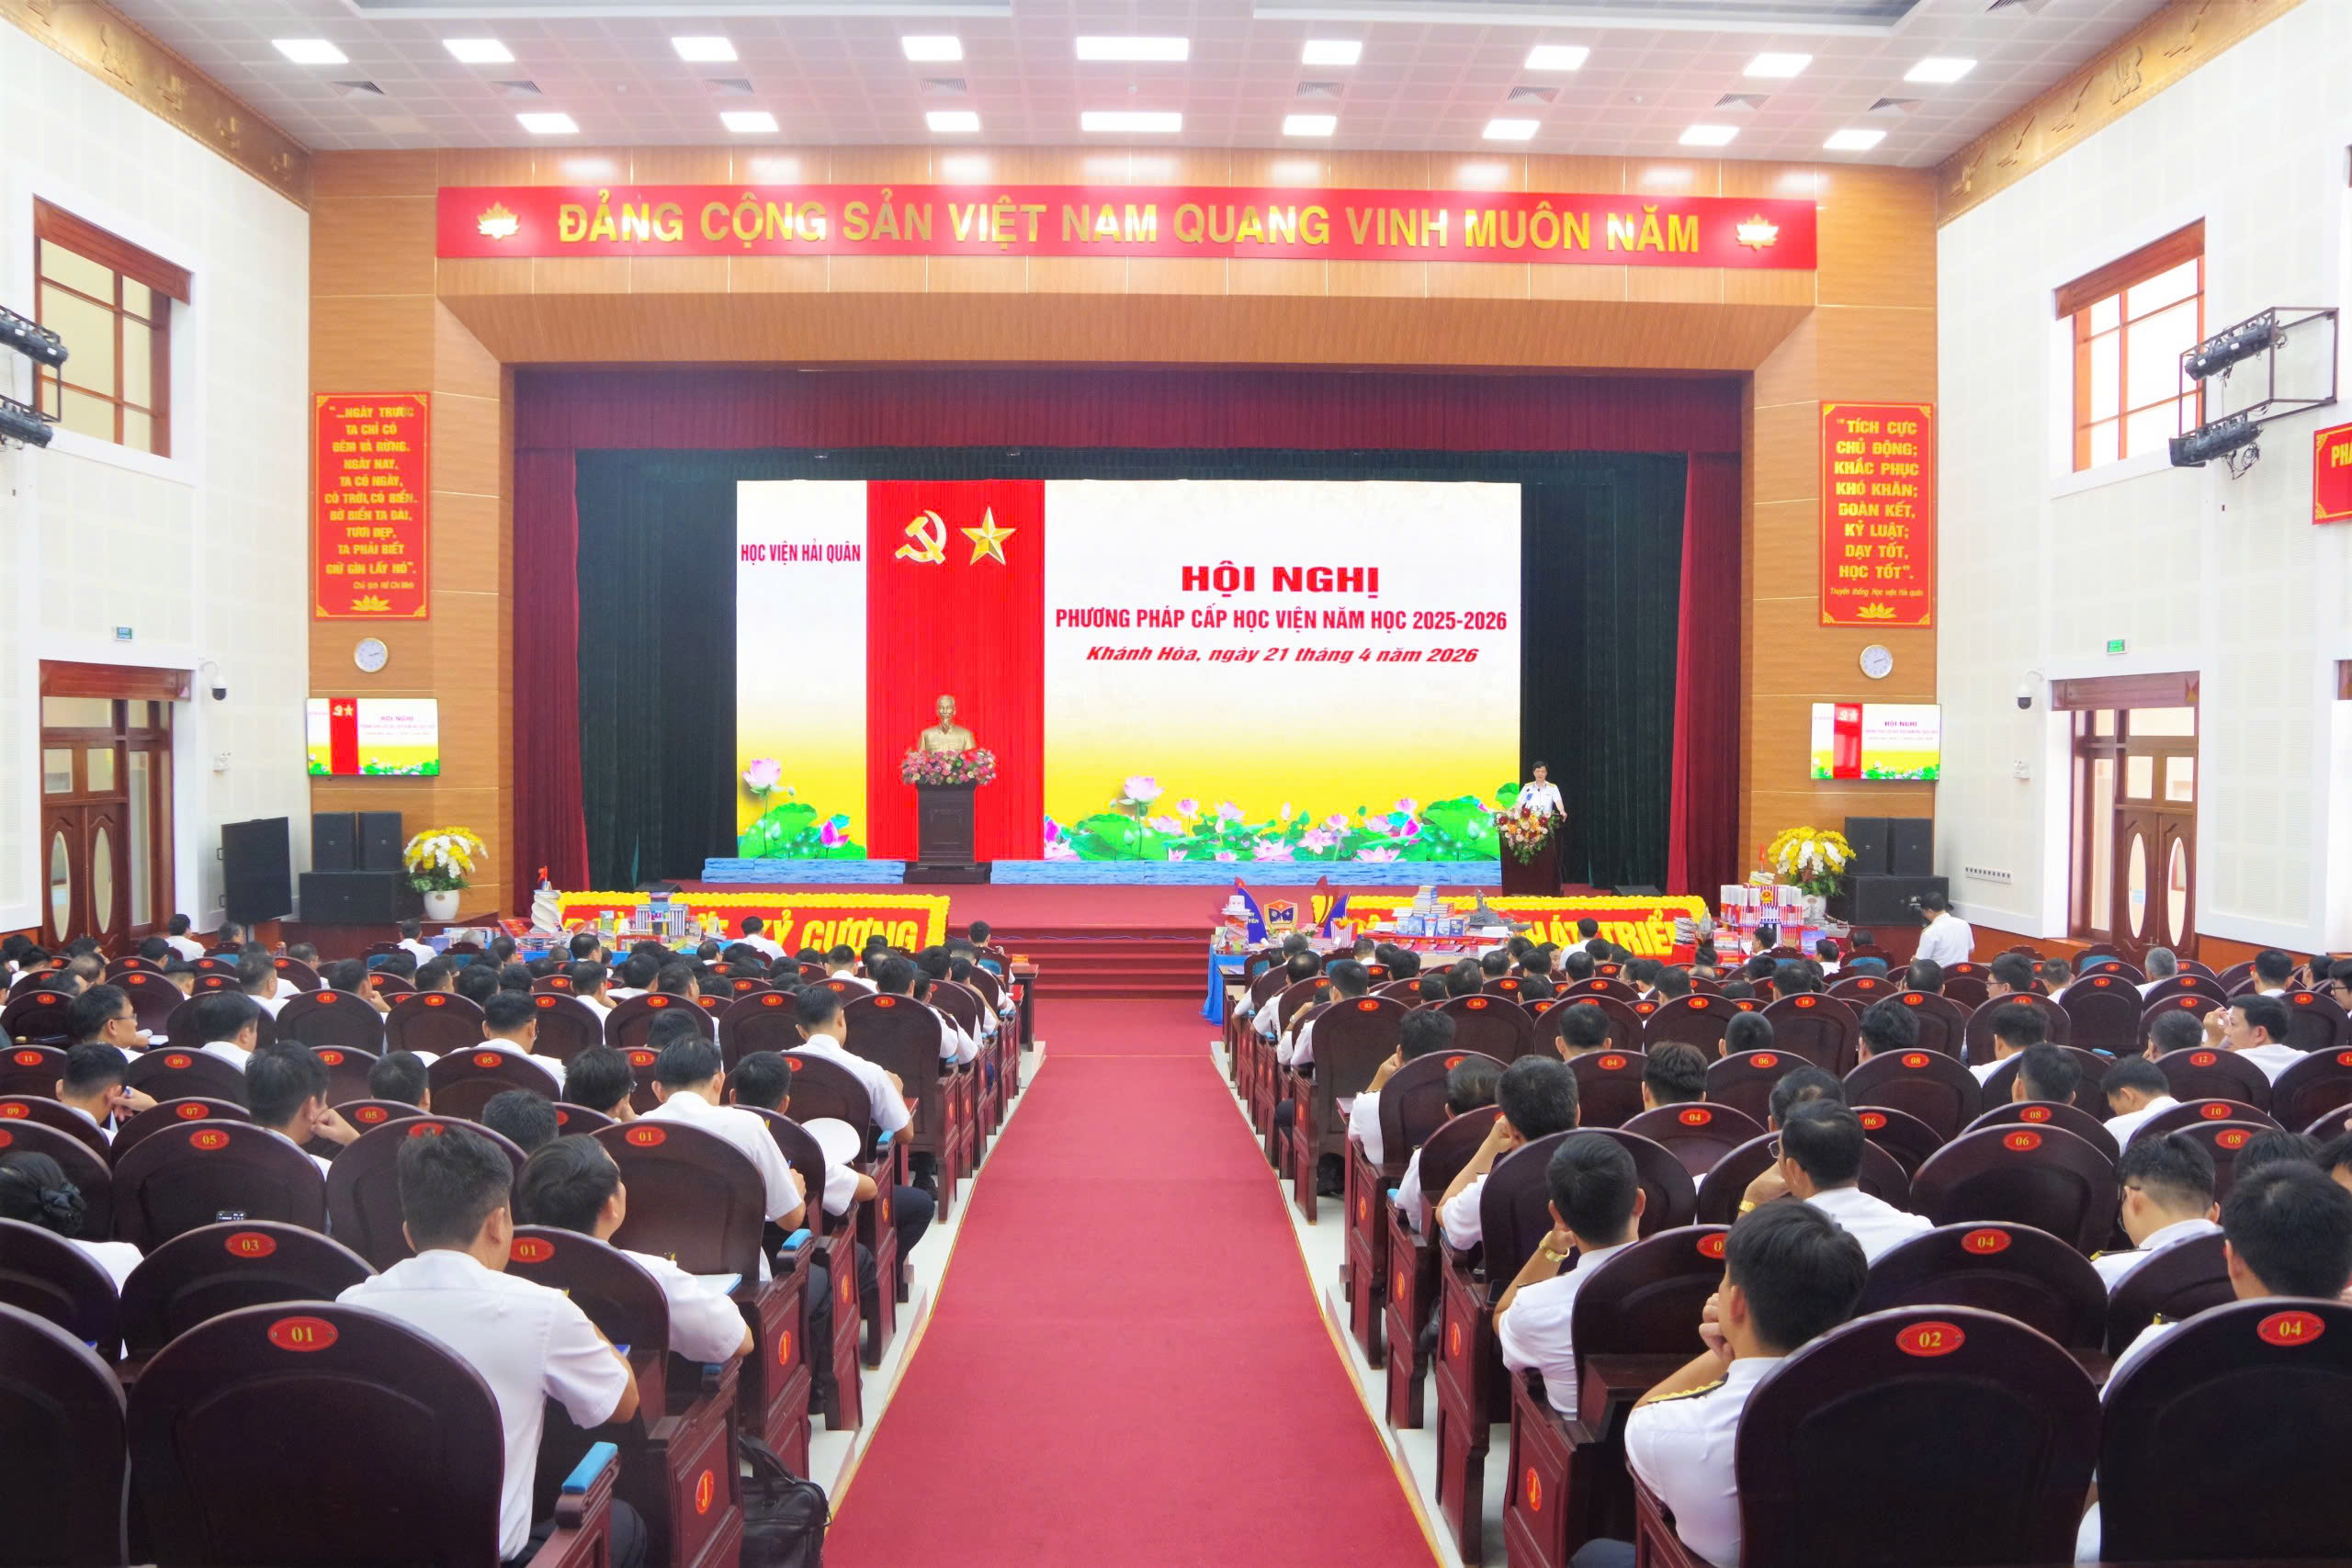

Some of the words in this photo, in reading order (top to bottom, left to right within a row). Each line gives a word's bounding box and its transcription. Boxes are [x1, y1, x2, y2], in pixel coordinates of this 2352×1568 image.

[558, 189, 684, 243] ĐẢNG
[700, 191, 828, 249] CỘNG
[842, 187, 933, 242] SẢN
[947, 195, 1046, 250] VIỆT
[1061, 202, 1158, 243] NAM
[1173, 203, 1330, 245] QUANG
[1344, 206, 1449, 248] VINH
[1464, 200, 1590, 253] MUÔN
[1605, 203, 1700, 254] NĂM
[1887, 420, 1917, 438] CỰC
[1836, 437, 1866, 455] CHỦ
[1871, 439, 1917, 457] ĐỘNG;
[1834, 457, 1874, 475] KHẮC
[1880, 462, 1919, 478] PHỤC
[1836, 479, 1866, 496] KHÓ
[1838, 501, 1880, 516] ĐOÀN
[1883, 500, 1916, 519] KẾT,
[1844, 519, 1865, 537] KỶ
[1870, 522, 1910, 540] LUẬT;
[741, 544, 766, 566] HỌC
[769, 539, 798, 566] VIỆN
[801, 537, 823, 562] HẢI
[826, 540, 861, 563] QUÂN
[1844, 544, 1873, 560] DẠY
[1878, 541, 1909, 560] TỐT,
[1182, 559, 1255, 598] HỘI
[1272, 565, 1379, 599] NGHỊ
[1838, 565, 1869, 581] HỌC
[1056, 606, 1131, 629] PHƯƠNG
[1136, 605, 1185, 628] PHÁP
[1191, 603, 1227, 629] CẤP
[1233, 609, 1270, 633] HỌC
[1275, 606, 1317, 634] VIỆN
[1322, 604, 1365, 630] NĂM
[1371, 610, 1407, 634] HỌC
[1412, 610, 1508, 631] 2025-2026
[1086, 646, 1153, 662] Khánh
[1158, 646, 1202, 663] Hòa,
[1208, 647, 1261, 664] ngày
[1264, 647, 1288, 661] 21
[1295, 646, 1354, 665] tháng
[1358, 648, 1372, 662] 4
[1376, 647, 1422, 662] năm
[1426, 648, 1479, 663] 2026
[800, 917, 920, 954] CƯƠNG
[24, 1055, 33, 1063] 11
[172, 1057, 184, 1066] 09
[323, 1054, 335, 1062] 07
[481, 1056, 493, 1065] 05
[635, 1055, 646, 1063] 03
[1910, 1056, 1921, 1065] 08
[2199, 1055, 2208, 1064] 12
[6, 1108, 20, 1116] 09
[186, 1107, 198, 1116] 07
[365, 1111, 378, 1120] 05
[1689, 1113, 1702, 1122] 04
[2030, 1111, 2041, 1119] 08
[2211, 1107, 2222, 1116] 10
[1864, 1117, 1877, 1125] 06
[202, 1134, 217, 1145] 05
[639, 1131, 652, 1142] 01
[2015, 1136, 2030, 1146] 06
[2227, 1134, 2242, 1145] 08
[242, 1239, 260, 1251] 03
[1977, 1235, 1995, 1247] 04
[519, 1245, 537, 1257] 01
[291, 1326, 313, 1342] 01
[2278, 1320, 2302, 1337] 04
[1918, 1331, 1941, 1348] 02
[701, 1475, 708, 1507] J
[1530, 1474, 1538, 1504] J
